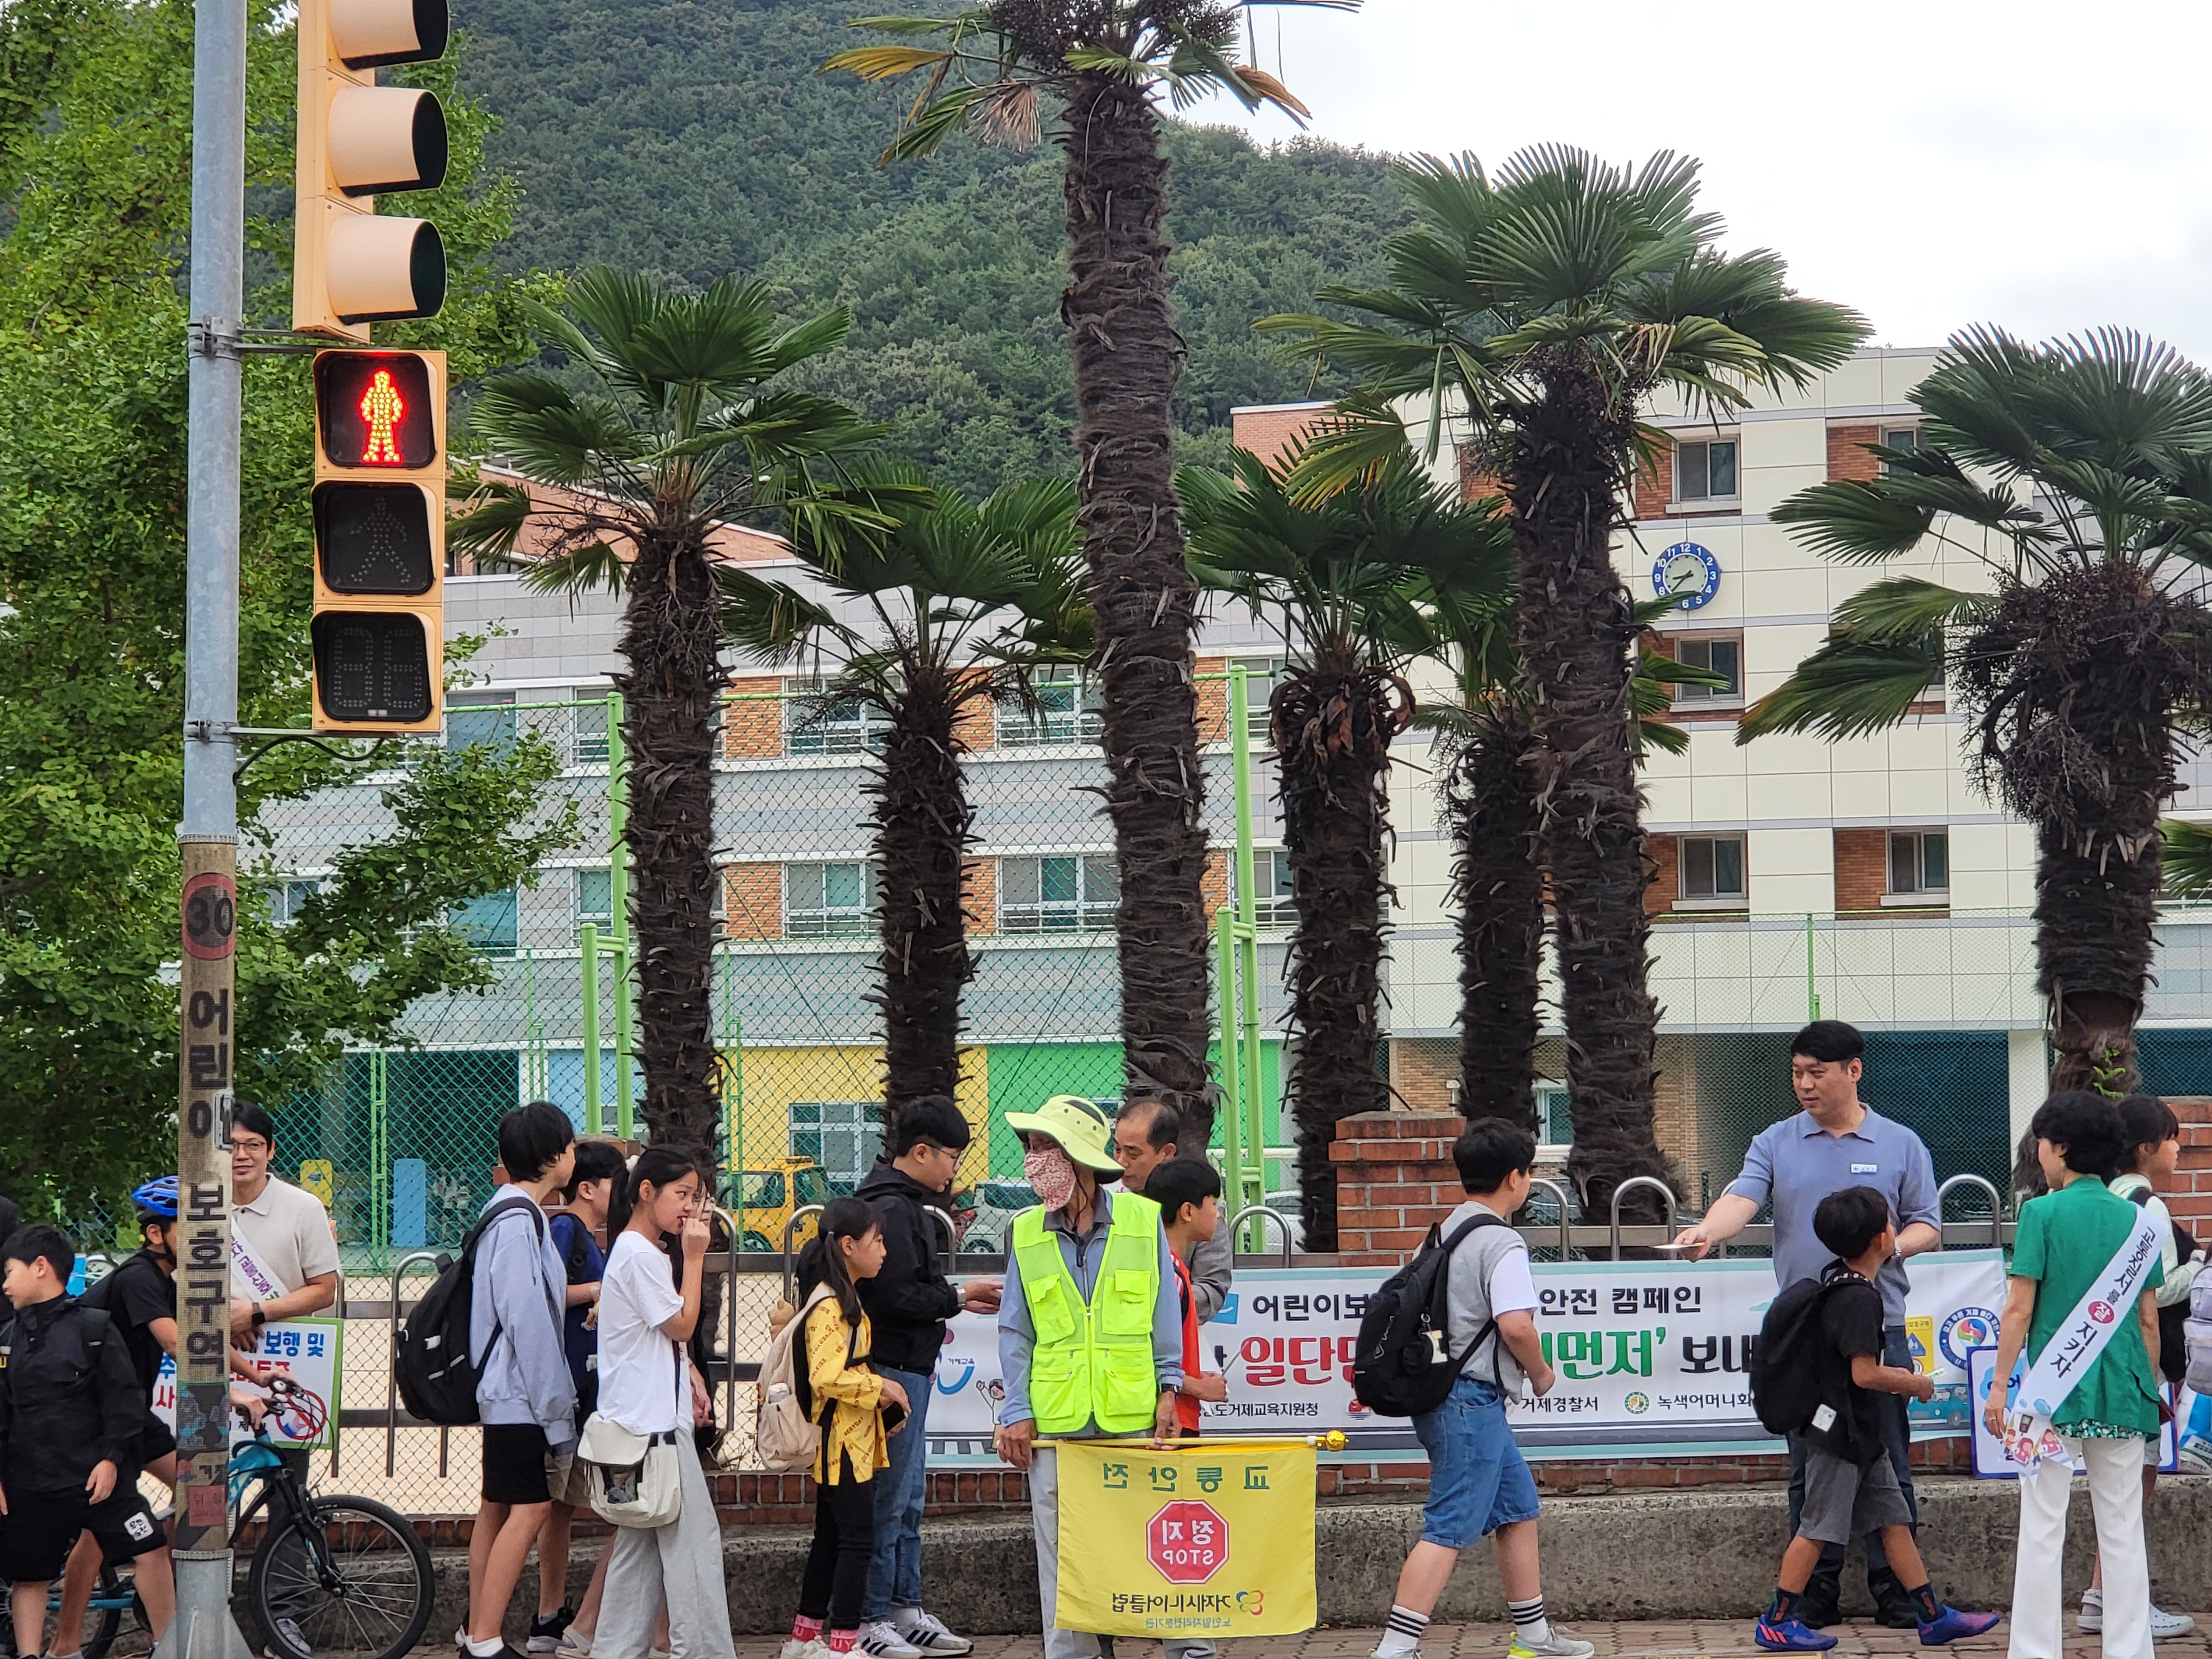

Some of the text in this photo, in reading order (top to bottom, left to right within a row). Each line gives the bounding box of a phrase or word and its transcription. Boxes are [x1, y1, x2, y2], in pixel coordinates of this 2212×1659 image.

[1666, 547, 1676, 557] 11
[1679, 543, 1691, 552] 12
[1697, 547, 1701, 556] 1
[1656, 558, 1666, 567] 10
[1706, 557, 1713, 566] 2
[1655, 573, 1661, 582] 9
[1709, 571, 1717, 580] 3
[1658, 587, 1665, 596] 8
[1705, 585, 1712, 593] 4
[1682, 599, 1689, 608] 6
[1695, 596, 1702, 604] 5
[185, 896, 233, 937] 30
[185, 1185, 227, 1378] 보호구역
[1539, 1288, 1597, 1316] 안전
[1611, 1286, 1701, 1314] 캠페인
[264, 1331, 325, 1358] 보행 및
[2049, 1321, 2099, 1379] 지키자
[1521, 1396, 1599, 1413] 거제경찰서
[1657, 1392, 1752, 1410] 녹색어머니회
